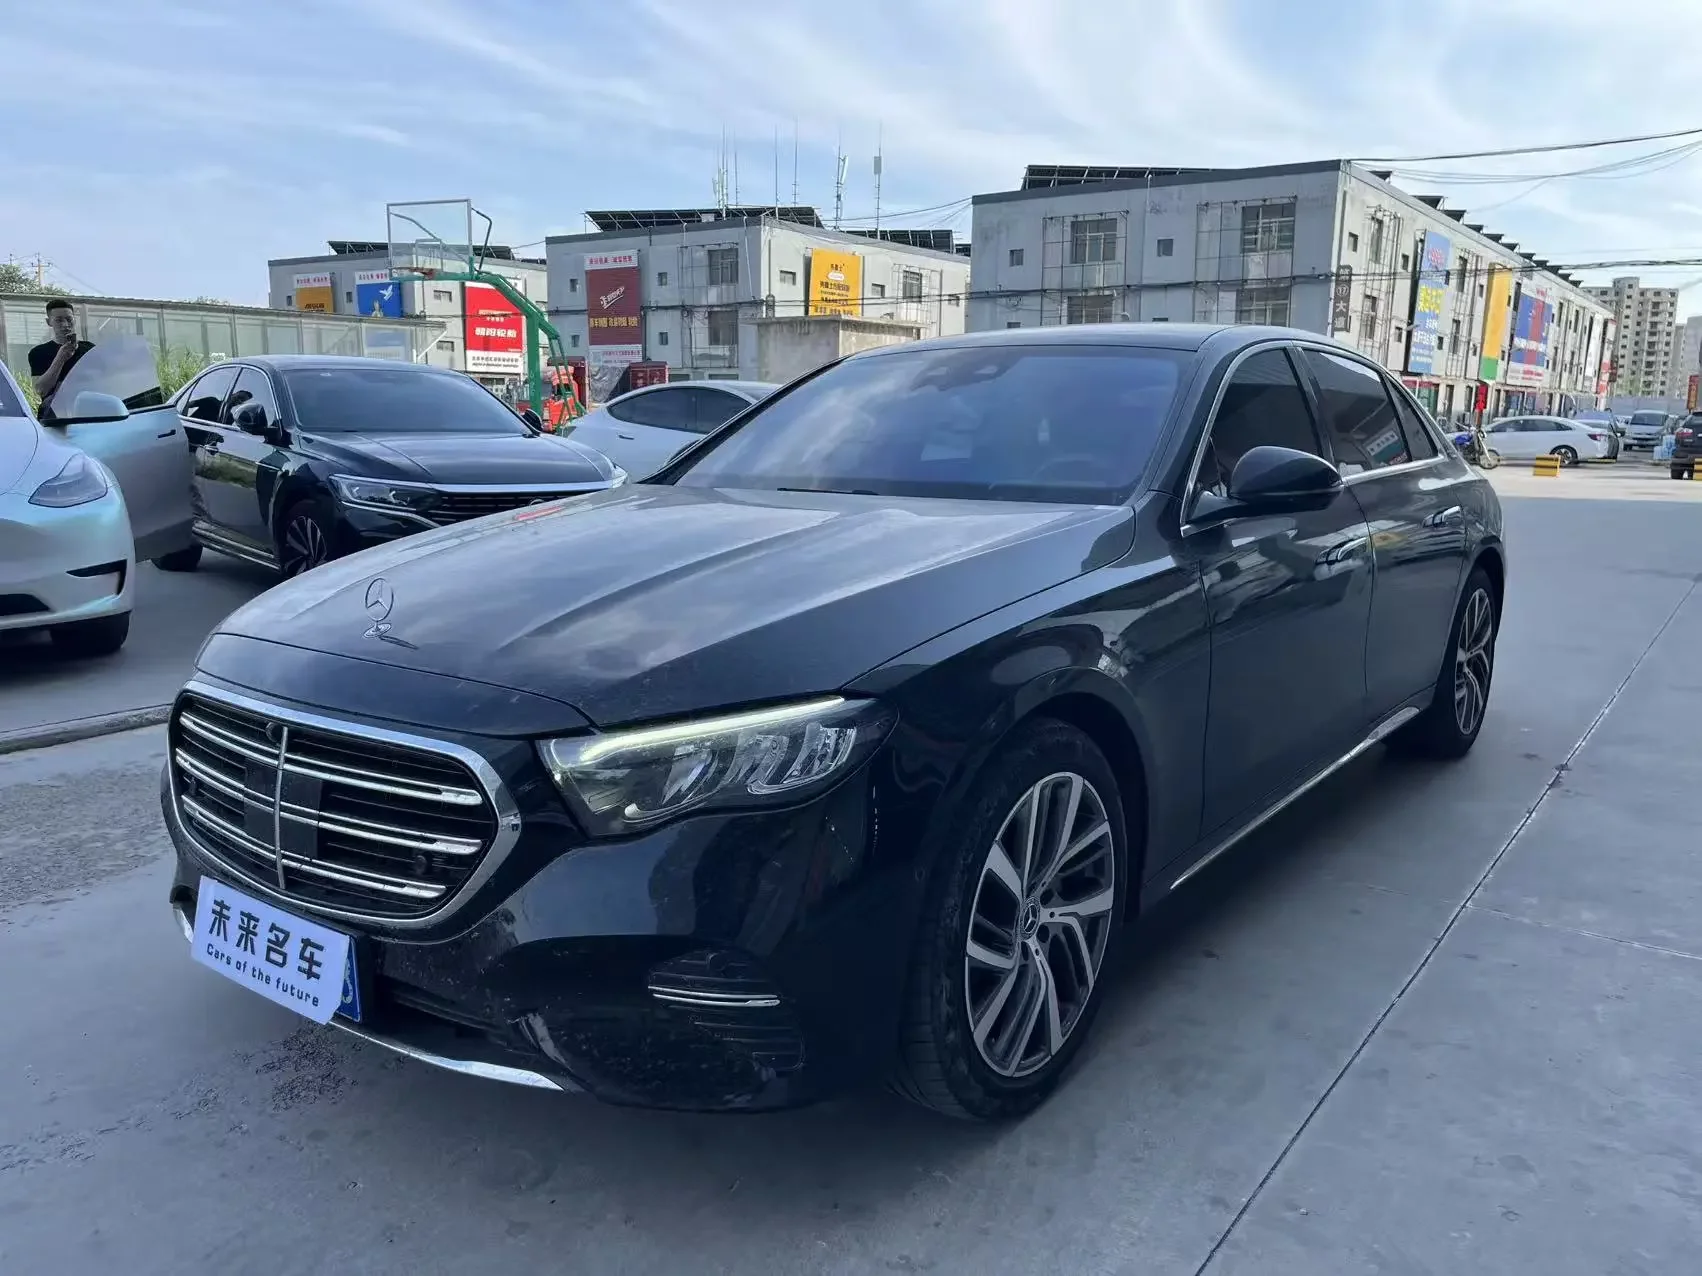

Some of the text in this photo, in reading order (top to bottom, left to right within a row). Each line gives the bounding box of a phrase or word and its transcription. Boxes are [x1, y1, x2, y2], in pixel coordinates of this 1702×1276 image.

[206, 943, 232, 966] Cars
[235, 959, 248, 973] of
[251, 966, 271, 985] the
[275, 977, 320, 1007] future
[208, 899, 325, 981] 未来名车
